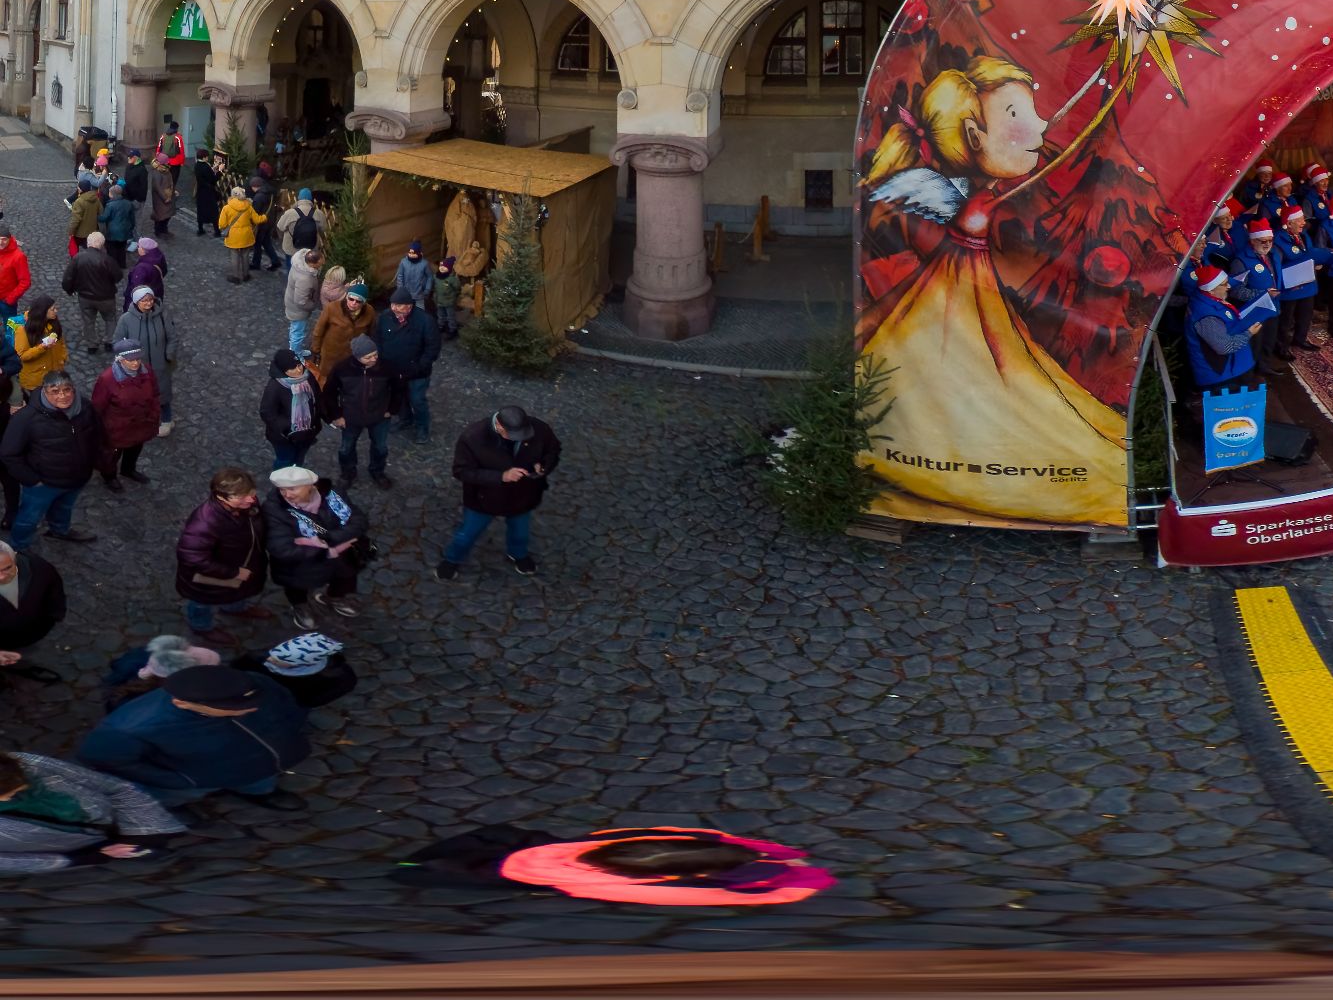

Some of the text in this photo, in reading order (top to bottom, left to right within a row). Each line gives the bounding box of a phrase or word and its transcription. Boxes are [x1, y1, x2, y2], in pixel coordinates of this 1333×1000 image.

[885, 448, 1088, 477] Kultur Service
[1245, 513, 1333, 535] Sparkasse
